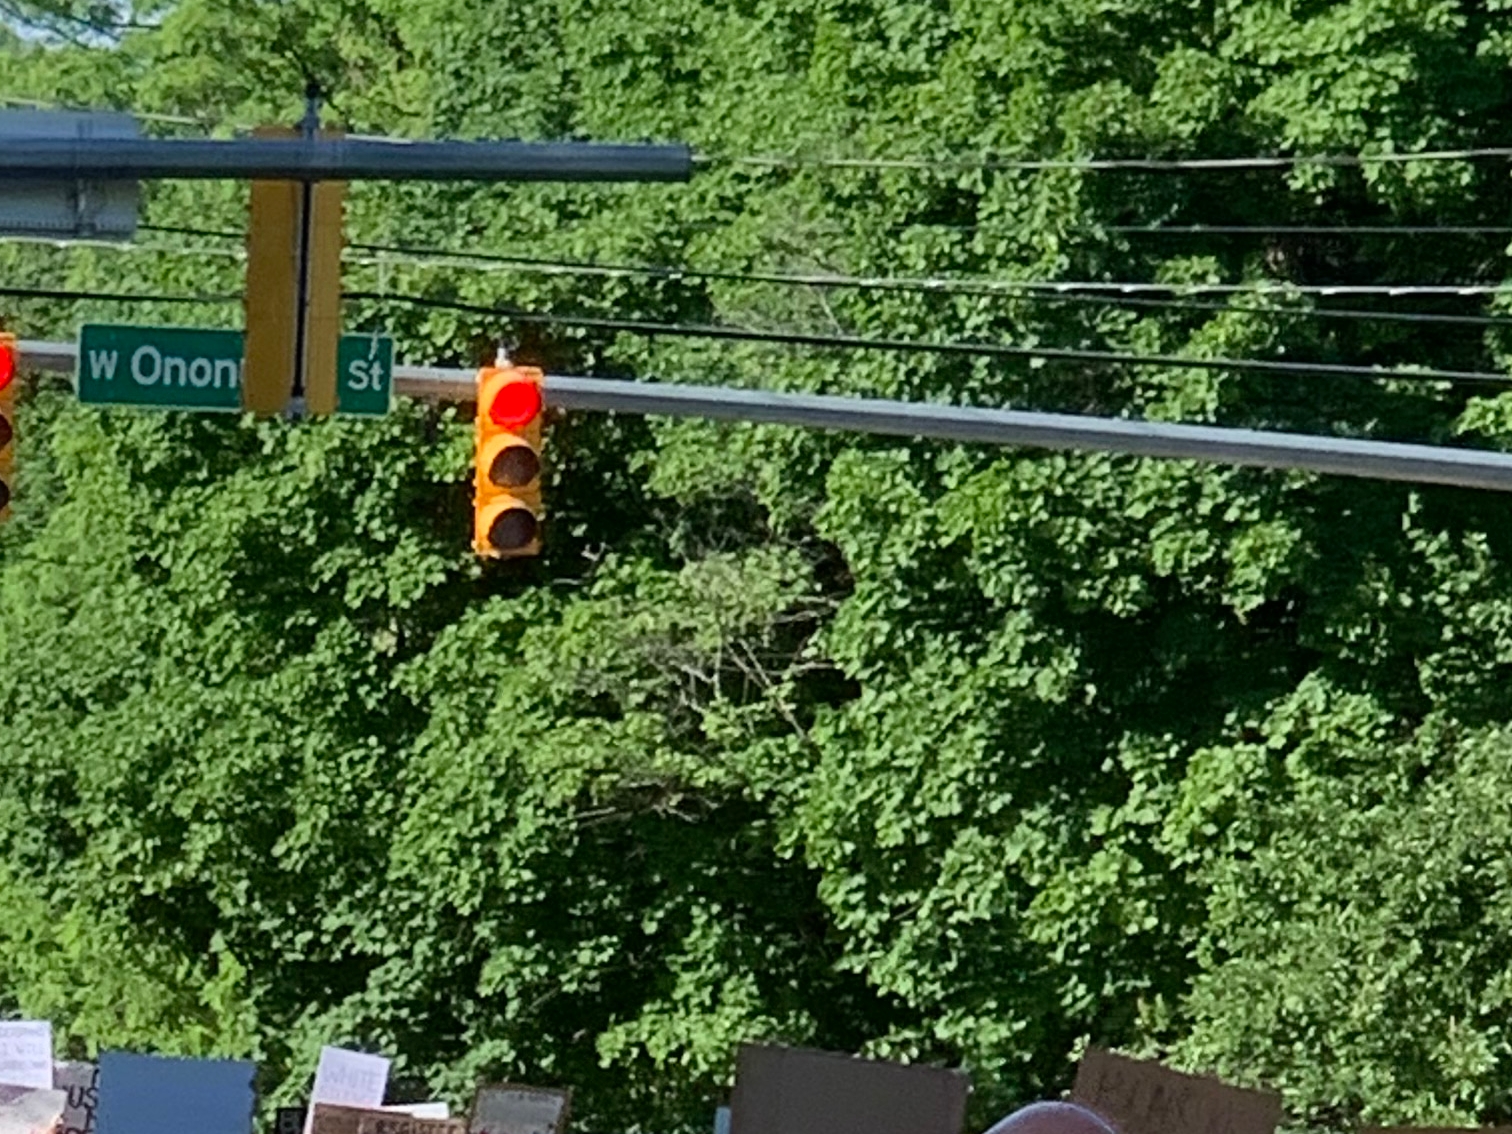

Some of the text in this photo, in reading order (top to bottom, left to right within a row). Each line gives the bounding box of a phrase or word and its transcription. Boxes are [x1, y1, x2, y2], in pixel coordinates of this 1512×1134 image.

[88, 345, 385, 392] W Onon St
